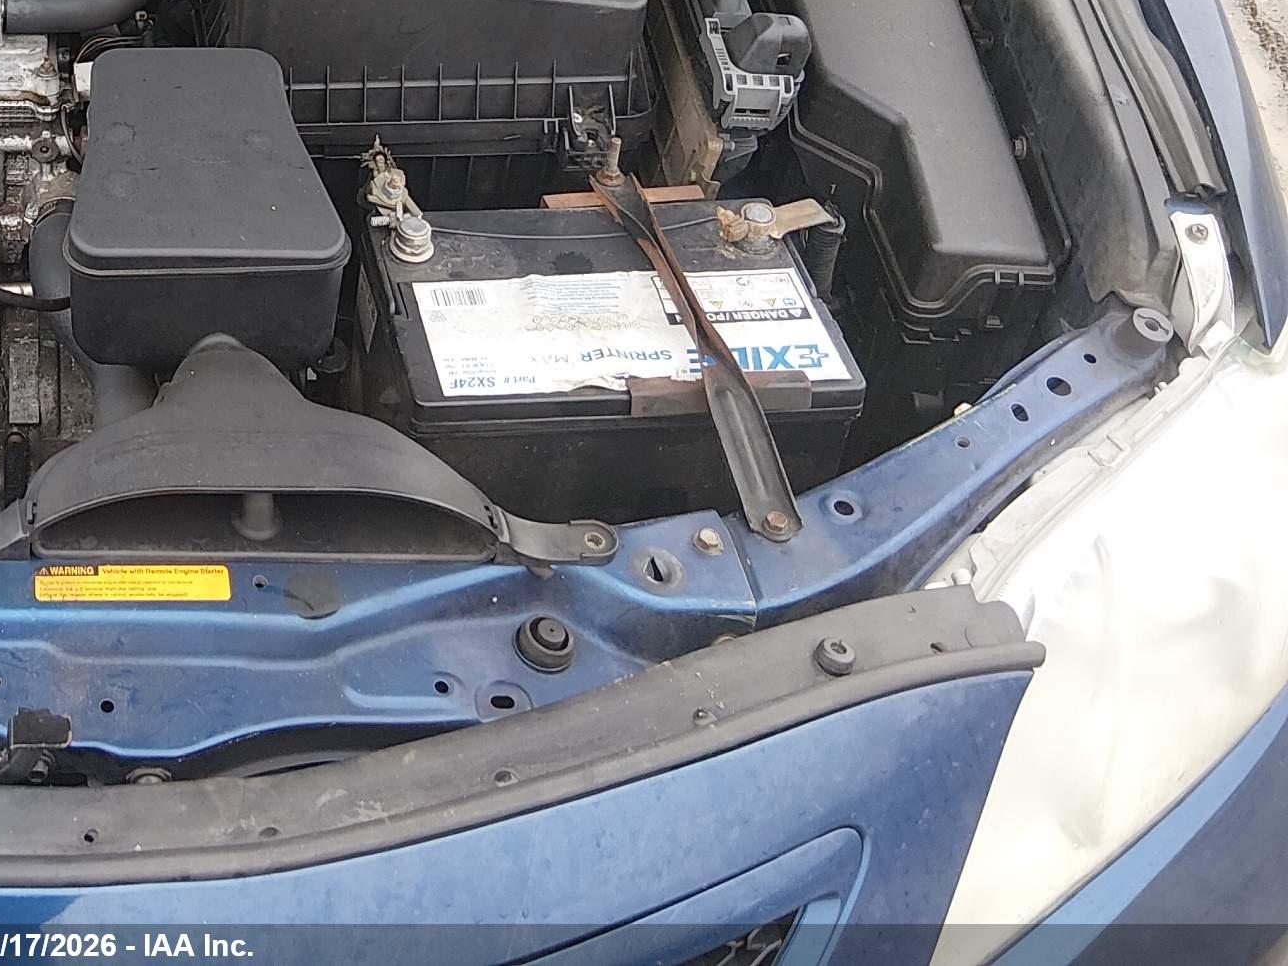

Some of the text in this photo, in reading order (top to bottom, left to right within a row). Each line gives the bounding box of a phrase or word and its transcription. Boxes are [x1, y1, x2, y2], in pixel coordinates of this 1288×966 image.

[734, 308, 789, 321] DANGER
[530, 347, 673, 363] SPRINTER MAX
[449, 376, 496, 389] SX24F
[513, 375, 536, 384] Part
[49, 566, 95, 576] WARNING
[102, 567, 127, 575] Vehicle
[129, 567, 144, 575] with
[145, 567, 173, 575] Remote
[174, 568, 199, 577] Engine
